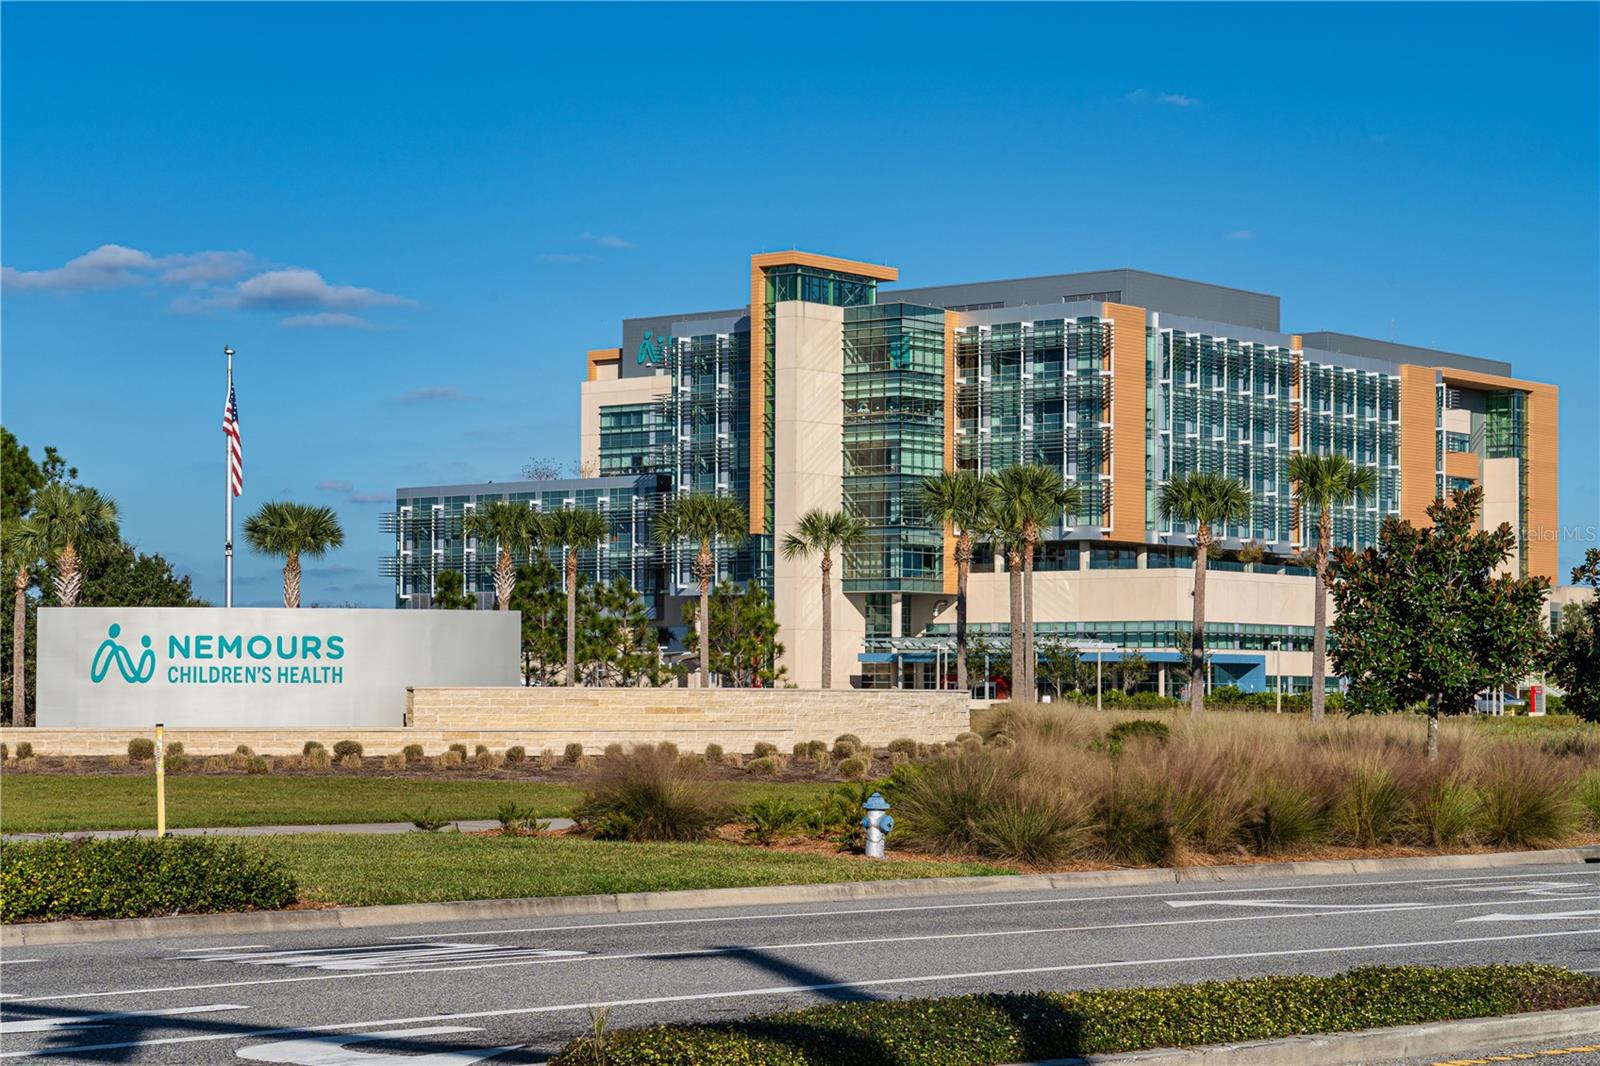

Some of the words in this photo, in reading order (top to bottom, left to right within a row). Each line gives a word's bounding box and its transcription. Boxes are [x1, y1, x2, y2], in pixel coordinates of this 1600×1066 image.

[168, 635, 345, 660] NEMOURS
[167, 666, 272, 684] CHILDREN'S
[277, 666, 343, 684] HEALTH
